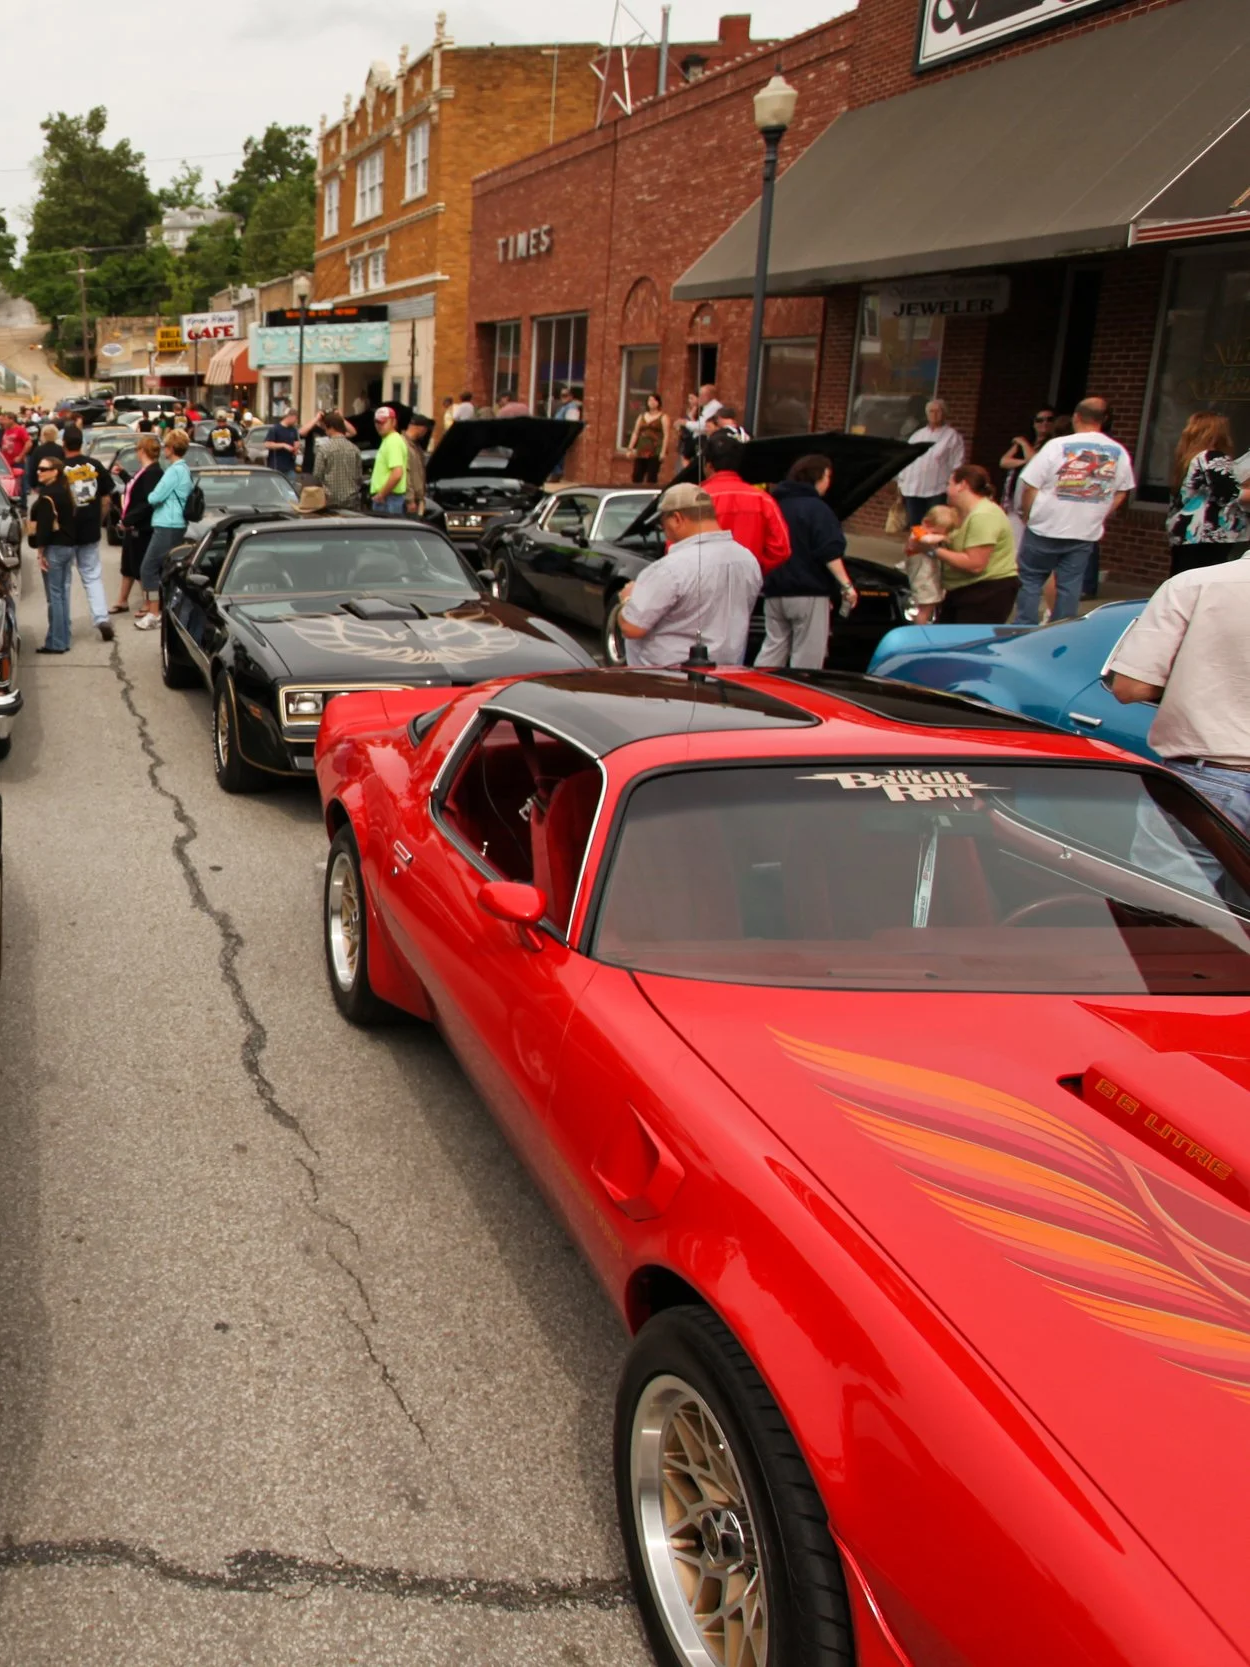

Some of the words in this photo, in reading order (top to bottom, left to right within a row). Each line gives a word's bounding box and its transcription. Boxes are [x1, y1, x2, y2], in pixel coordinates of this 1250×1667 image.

[496, 227, 551, 264] TIMES
[893, 299, 994, 316] JEWELER
[187, 325, 235, 341] CAFE
[836, 771, 974, 789] Bandit
[881, 785, 974, 802] Run
[1143, 1113, 1233, 1181] LITRE
